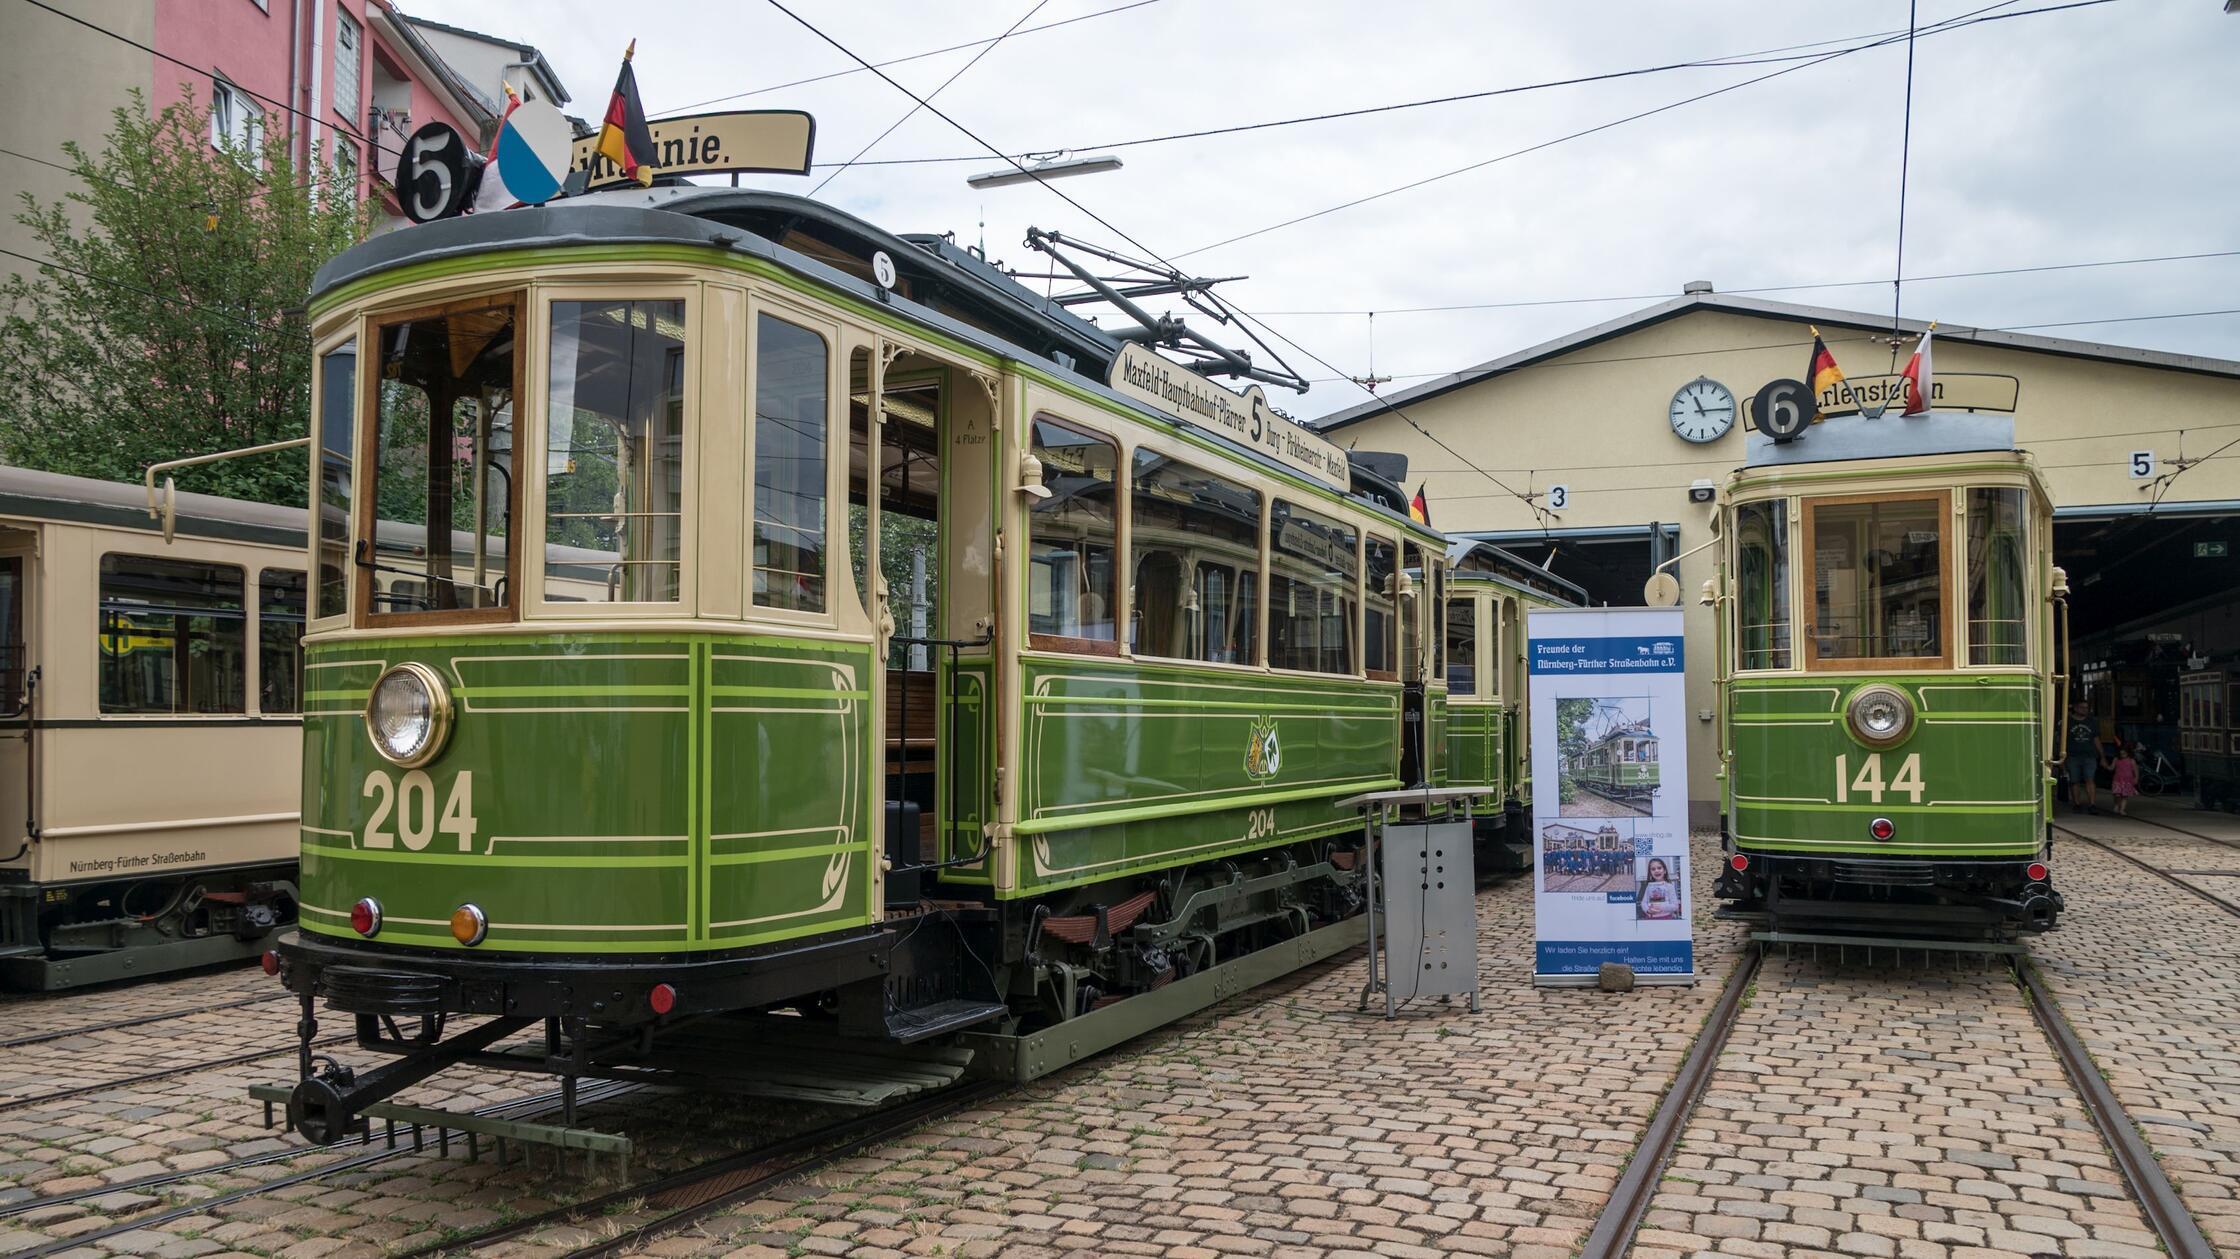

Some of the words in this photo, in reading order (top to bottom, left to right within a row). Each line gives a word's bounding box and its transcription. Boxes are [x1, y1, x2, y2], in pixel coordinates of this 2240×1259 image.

[412, 131, 452, 220] 5
[880, 257, 890, 282] 5
[1123, 352, 1247, 434] Maxfeld-Hauptbahnhof-Plärrer
[1250, 395, 1263, 442] 5
[1768, 385, 1800, 434] 6
[2133, 453, 2150, 476] 5
[1552, 486, 1566, 508] 3
[1537, 644, 1570, 654] Freunde
[1571, 644, 1586, 653] der
[1537, 658, 1607, 670] Nürnberg-Fürther
[1608, 657, 1660, 668] Straßenbahn
[1660, 657, 1676, 667] e.V.
[1835, 753, 1926, 803] 144
[363, 769, 478, 851] 204
[1248, 807, 1276, 840] 204
[69, 855, 150, 873] Nürnberg-Fürther
[151, 850, 206, 865] Straßenbahn
[1577, 946, 1589, 954] Sie
